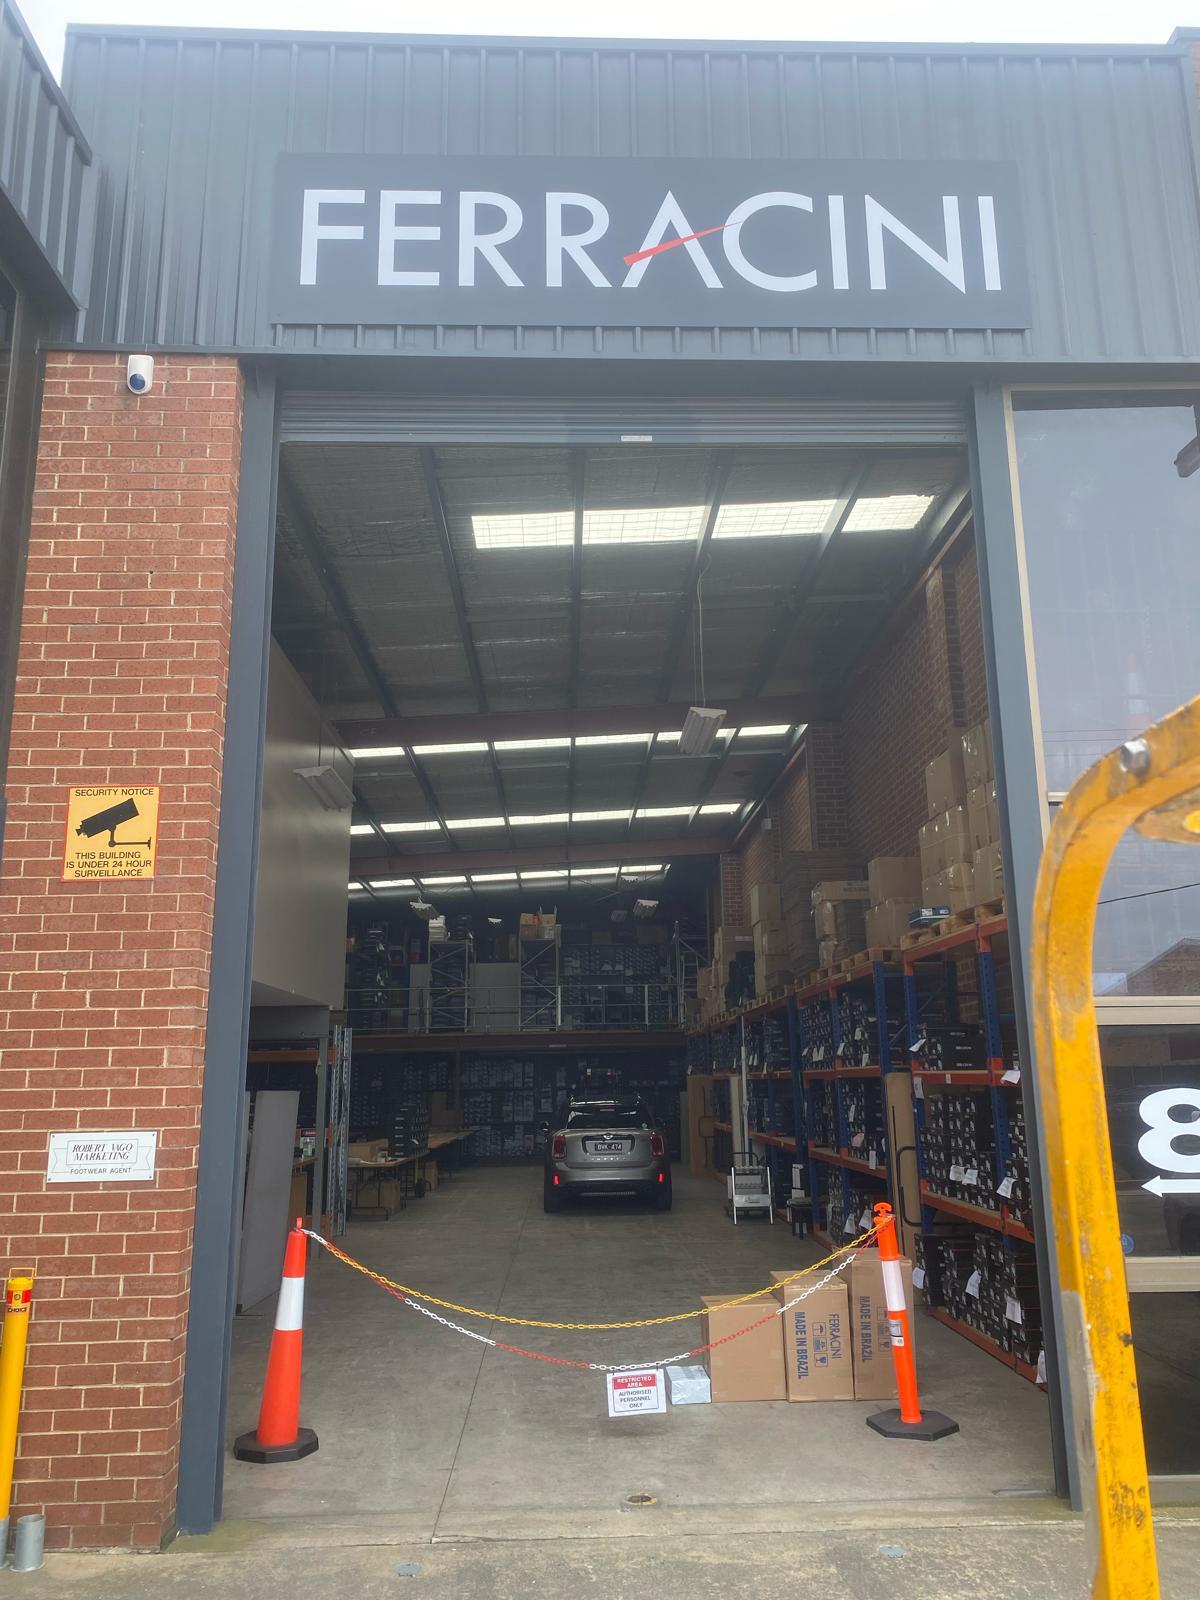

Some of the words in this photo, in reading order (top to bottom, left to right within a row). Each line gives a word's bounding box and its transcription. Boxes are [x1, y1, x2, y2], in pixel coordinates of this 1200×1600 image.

[299, 189, 1002, 294] FERRACINI
[121, 788, 154, 796] NOTICE
[75, 852, 96, 860] THIS
[98, 851, 141, 859] BUILDING
[66, 861, 75, 869] IS
[77, 861, 109, 869] UNDER
[125, 860, 152, 868] HOUR
[74, 869, 142, 877] SURVEILLANCE
[72, 1143, 106, 1152] ROBERT
[111, 1143, 134, 1151] VAGO
[74, 1151, 129, 1160] MARKETING
[859, 1296, 871, 1320] MADE
[794, 1312, 806, 1336] MADE
[860, 1322, 871, 1333] IN
[828, 1313, 842, 1360] FERRACINI
[796, 1338, 807, 1350] IN
[861, 1333, 873, 1363] BRAZIL
[797, 1349, 809, 1380] BRAZIL
